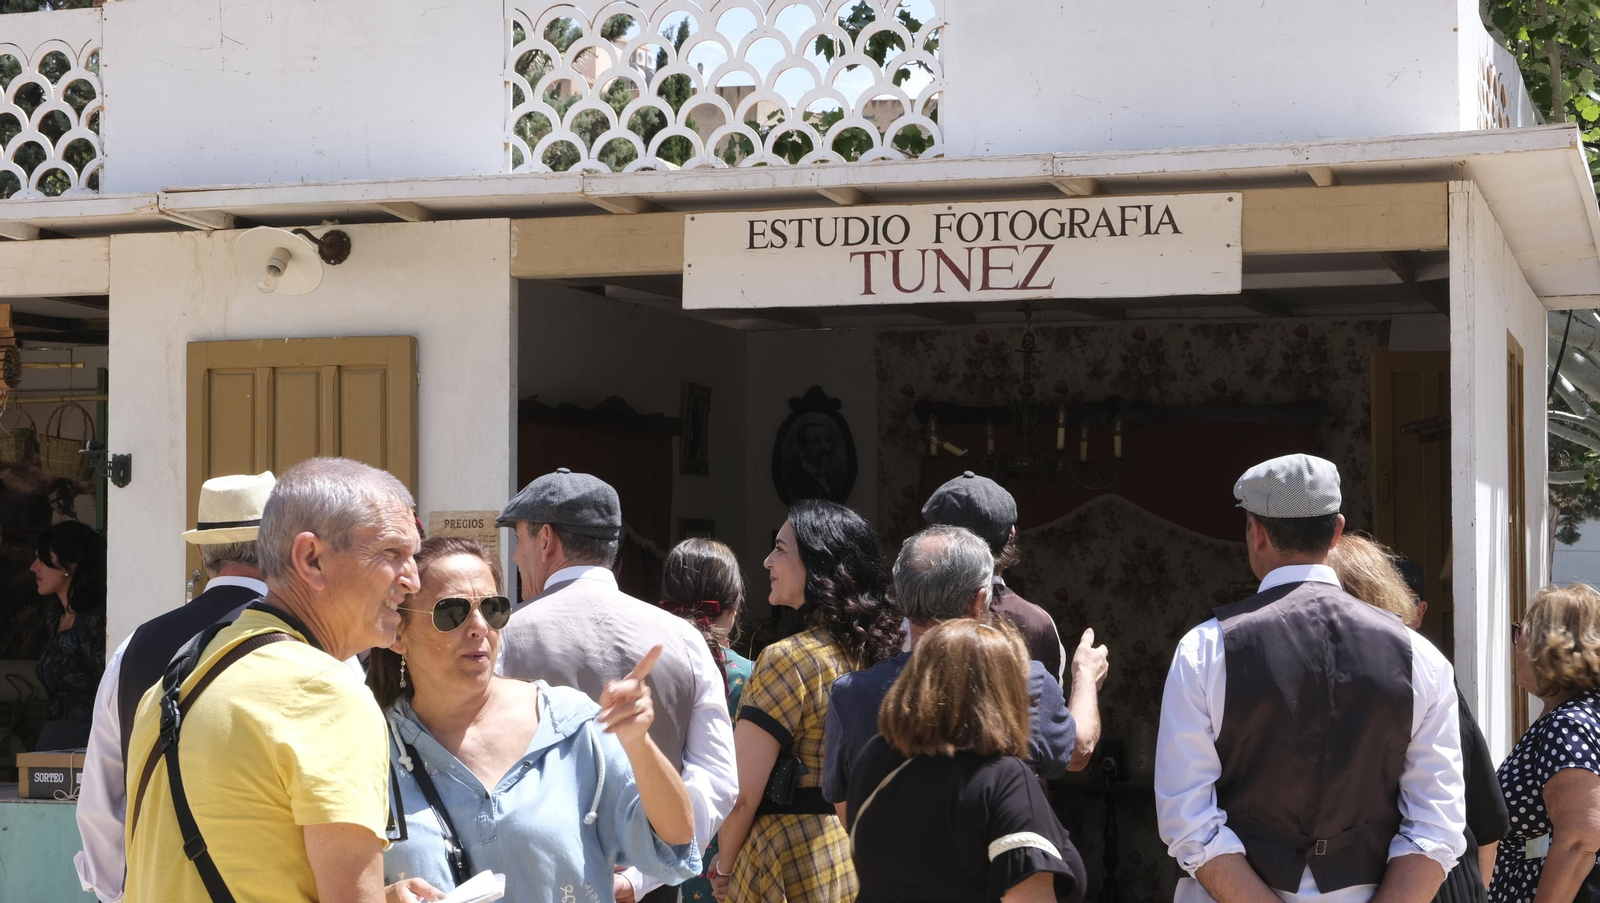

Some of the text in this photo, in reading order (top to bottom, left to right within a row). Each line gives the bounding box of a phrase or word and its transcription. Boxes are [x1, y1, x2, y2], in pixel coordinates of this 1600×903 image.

[746, 203, 1183, 251] ESTUDIO FOTOGRAFIA
[849, 243, 1056, 296] TUNEZ
[34, 772, 64, 783] SORTEO
